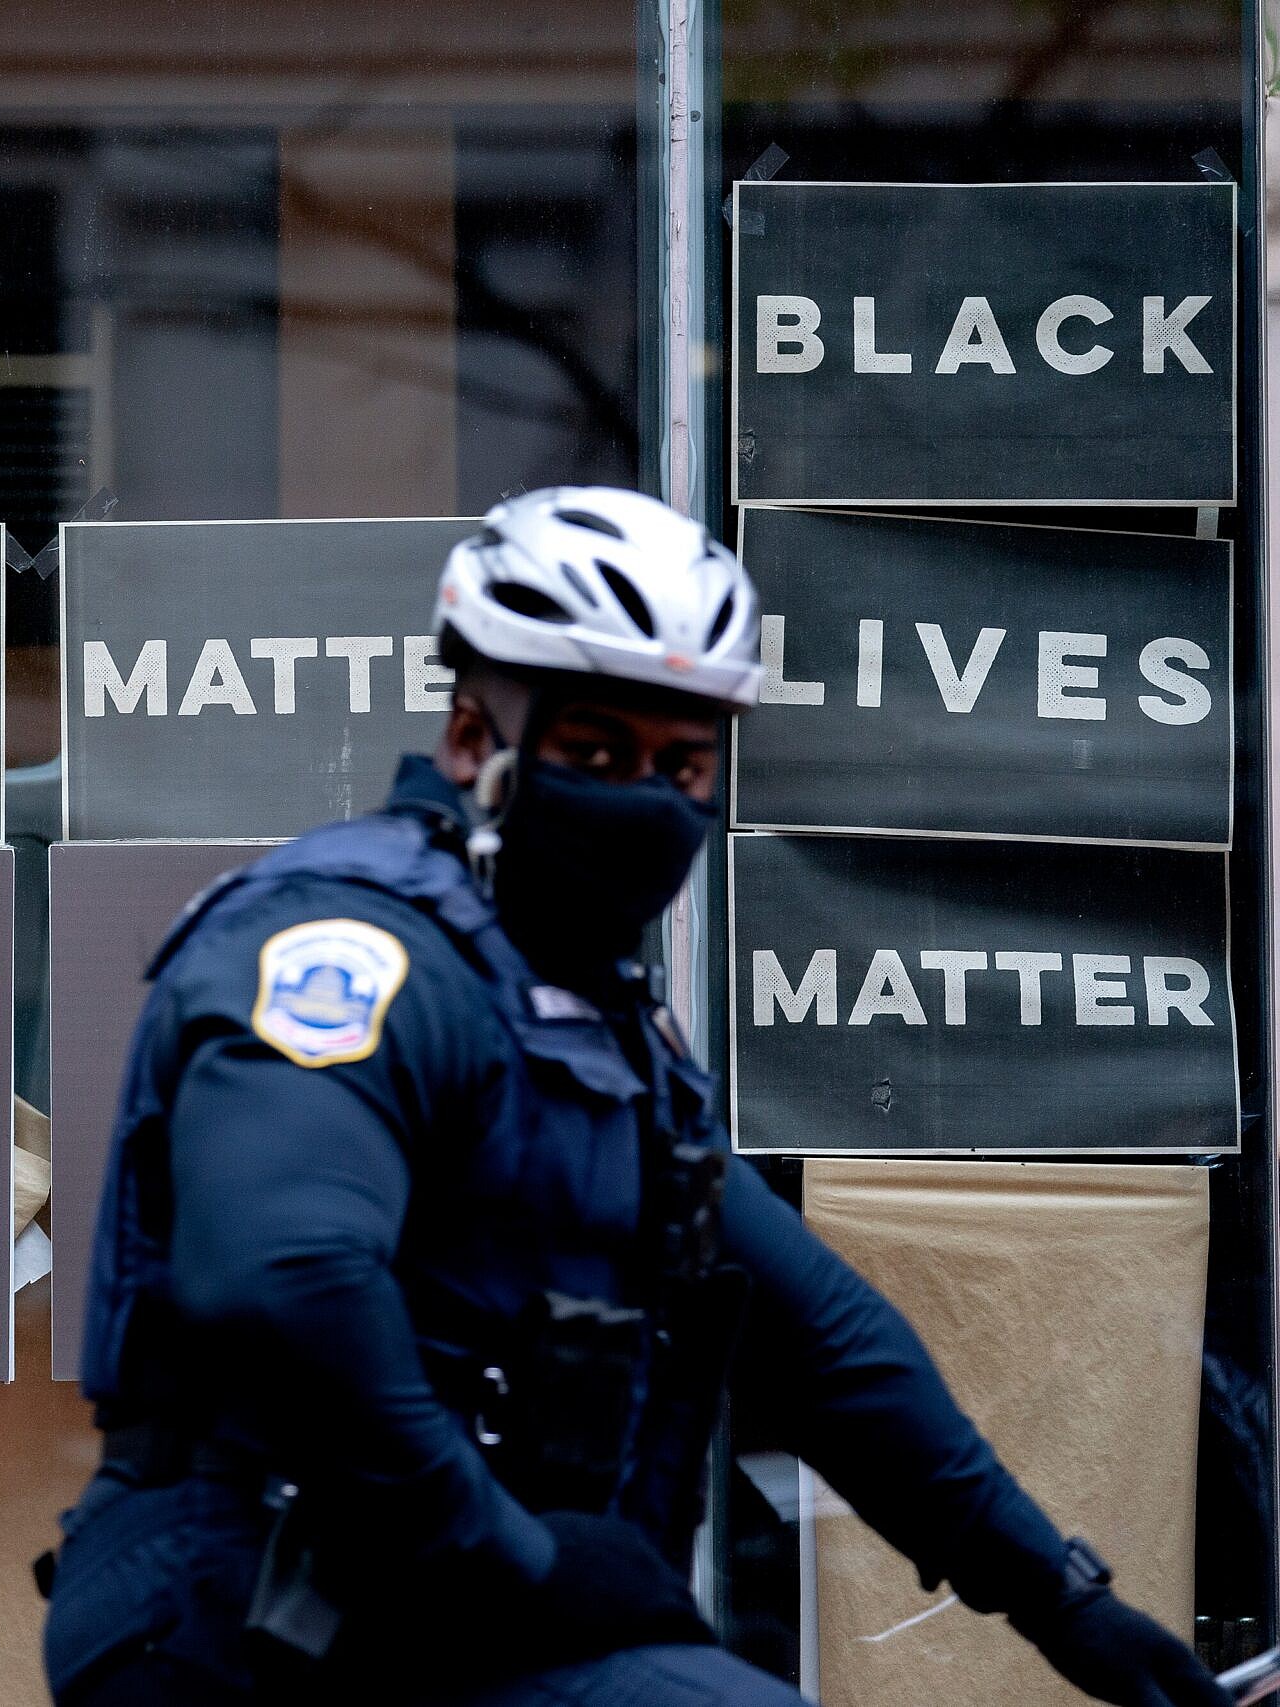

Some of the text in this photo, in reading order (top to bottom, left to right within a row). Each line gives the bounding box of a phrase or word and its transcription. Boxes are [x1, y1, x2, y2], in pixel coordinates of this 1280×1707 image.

[756, 295, 1214, 375] BLACK
[84, 636, 456, 717] MATTE
[759, 614, 1212, 725] LIVES
[752, 949, 1215, 1026] MATTER
